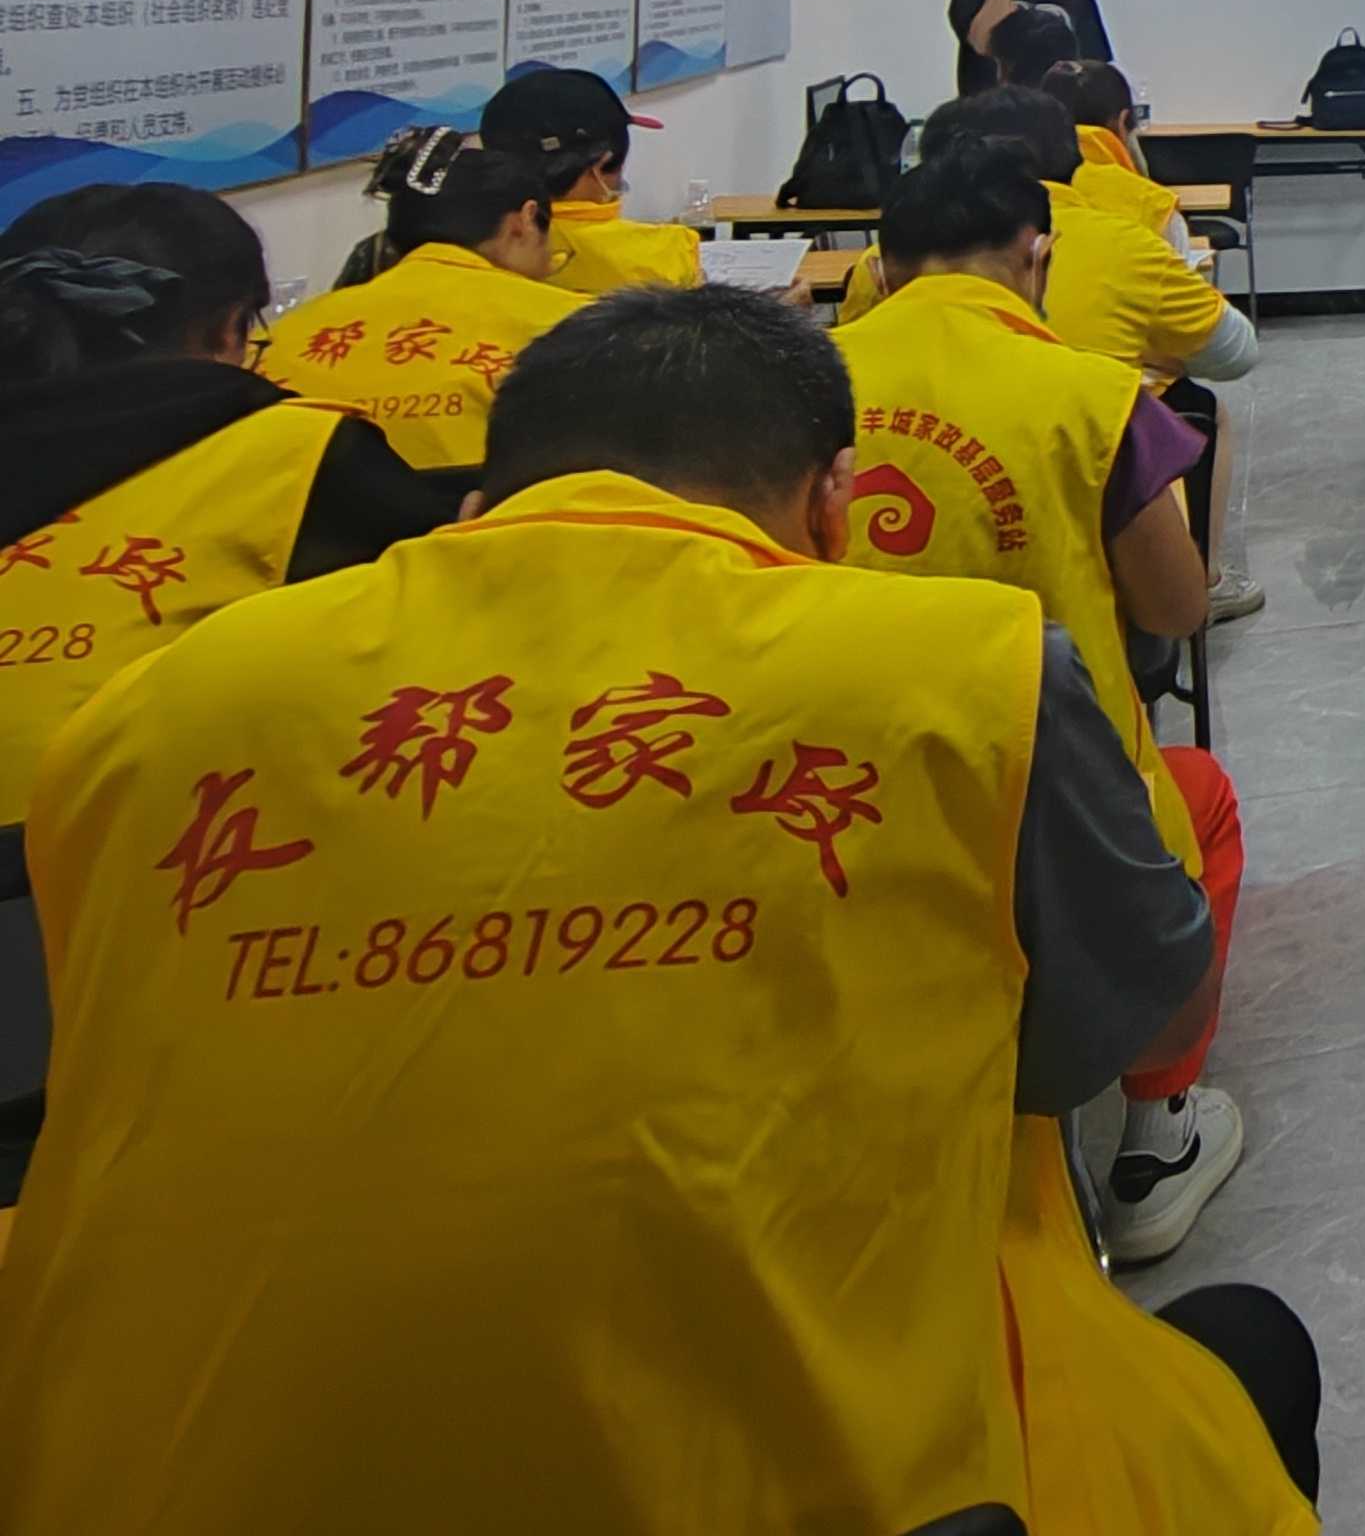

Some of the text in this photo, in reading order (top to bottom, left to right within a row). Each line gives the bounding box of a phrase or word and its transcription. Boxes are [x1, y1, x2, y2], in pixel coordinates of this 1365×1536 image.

[255, 319, 517, 393] 帮家政
[860, 406, 1029, 553] 羊城家政基层服务站
[224, 897, 759, 1002] TEL:86819228
